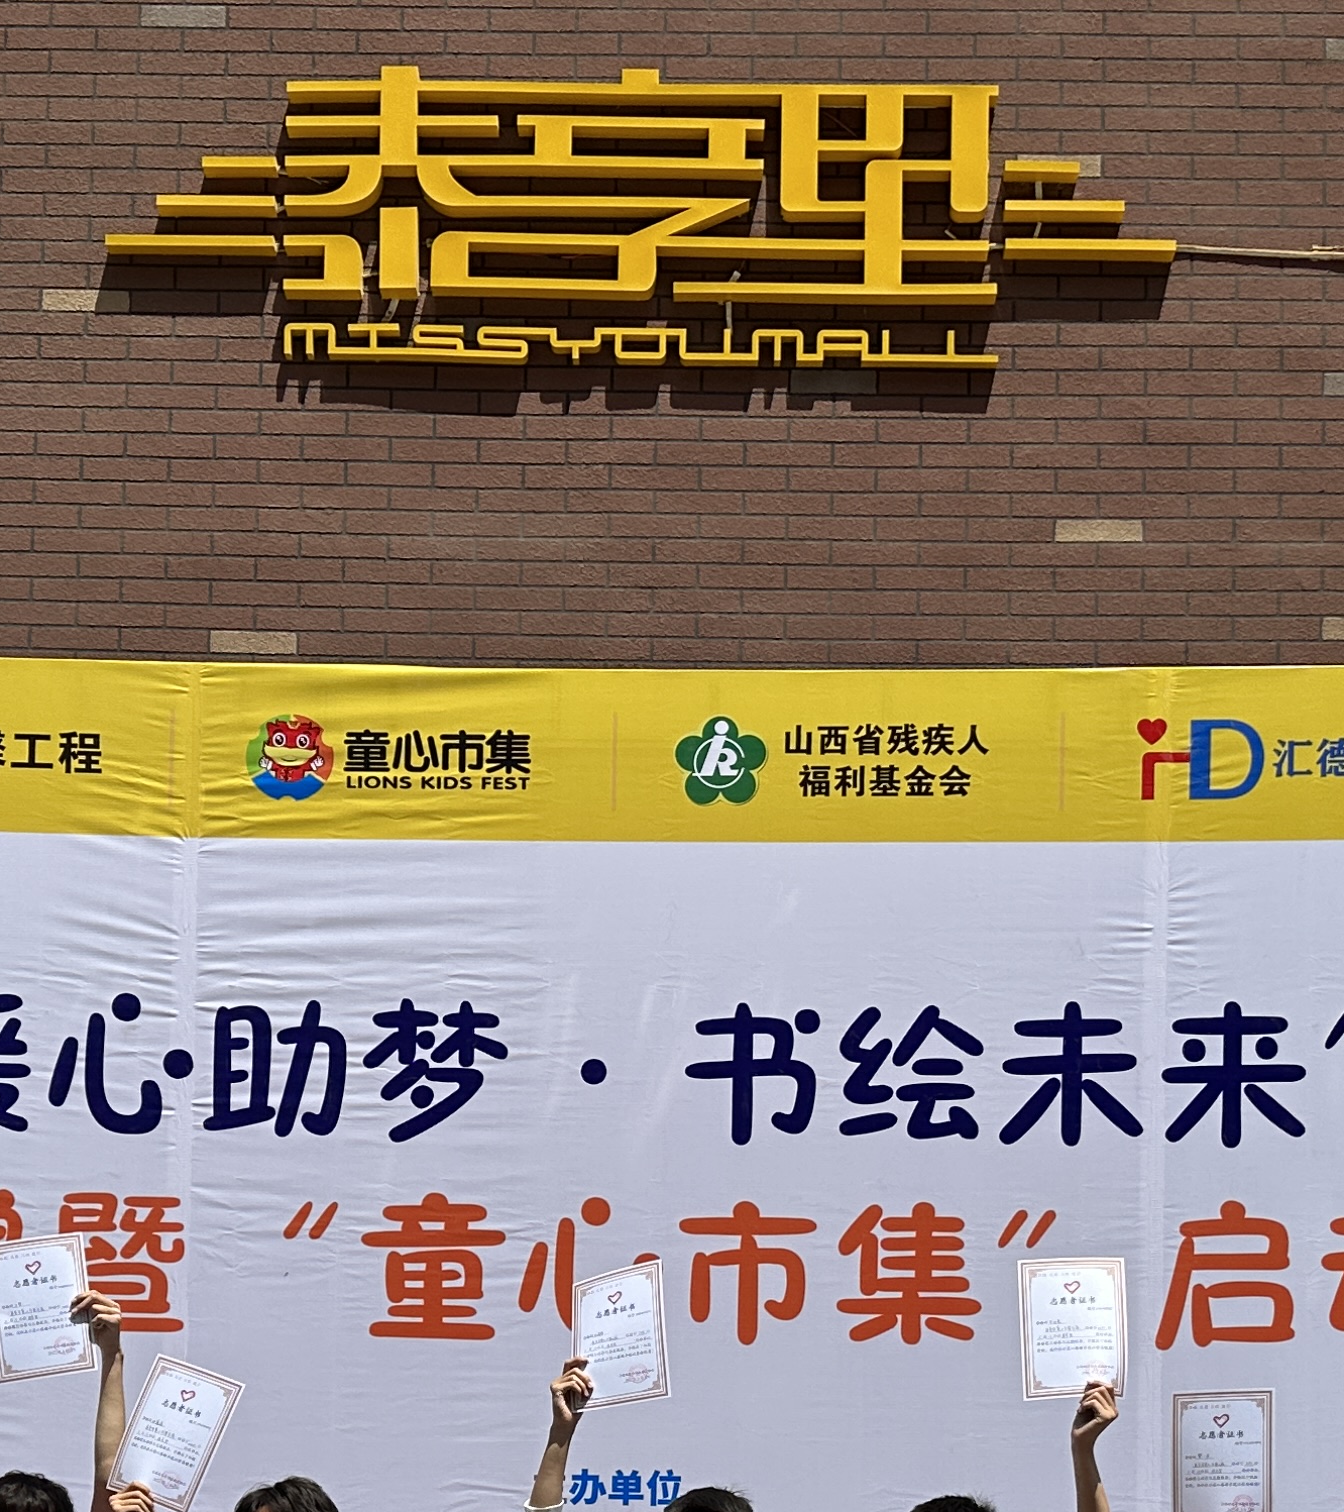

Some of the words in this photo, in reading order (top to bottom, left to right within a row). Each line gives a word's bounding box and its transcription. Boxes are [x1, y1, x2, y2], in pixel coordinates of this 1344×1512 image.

[343, 729, 531, 774] 童心市集
[784, 724, 990, 756] 山西省残疾人
[346, 775, 412, 789] LIONS
[421, 776, 473, 790] KIDS
[481, 777, 530, 790] FEST
[799, 764, 972, 797] 福利基金会
